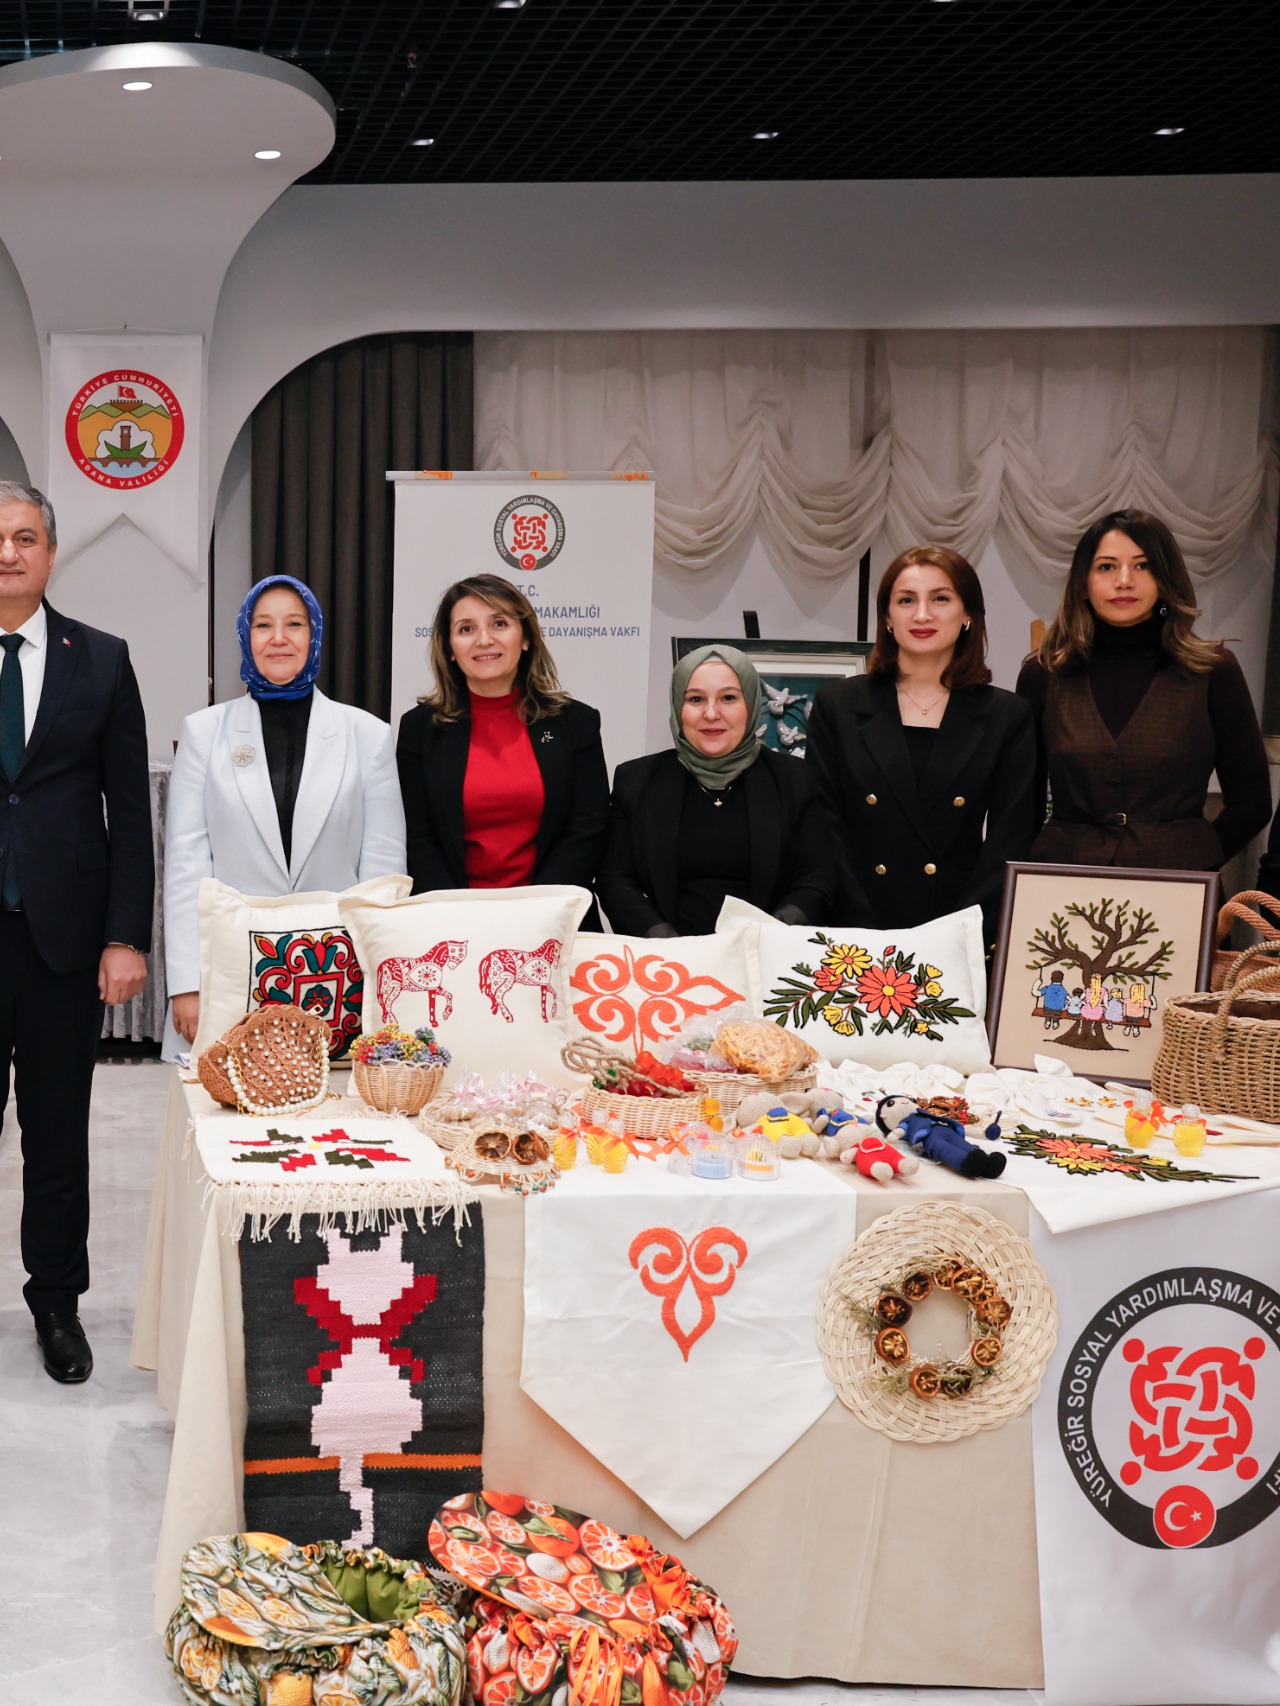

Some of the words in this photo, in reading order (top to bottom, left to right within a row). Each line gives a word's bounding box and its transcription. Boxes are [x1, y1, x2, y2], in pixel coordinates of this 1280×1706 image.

[78, 458, 112, 485] ADANA
[516, 584, 539, 597] T.C.
[548, 626, 608, 639] DAYANIŞMA
[610, 626, 640, 637] VAKFI
[1104, 1277, 1254, 1329] YARDIMLAŞMA
[1256, 1295, 1280, 1325] VE
[1067, 1330, 1113, 1408] SOSYAL
[1063, 1414, 1113, 1508] YÜREĞİR
